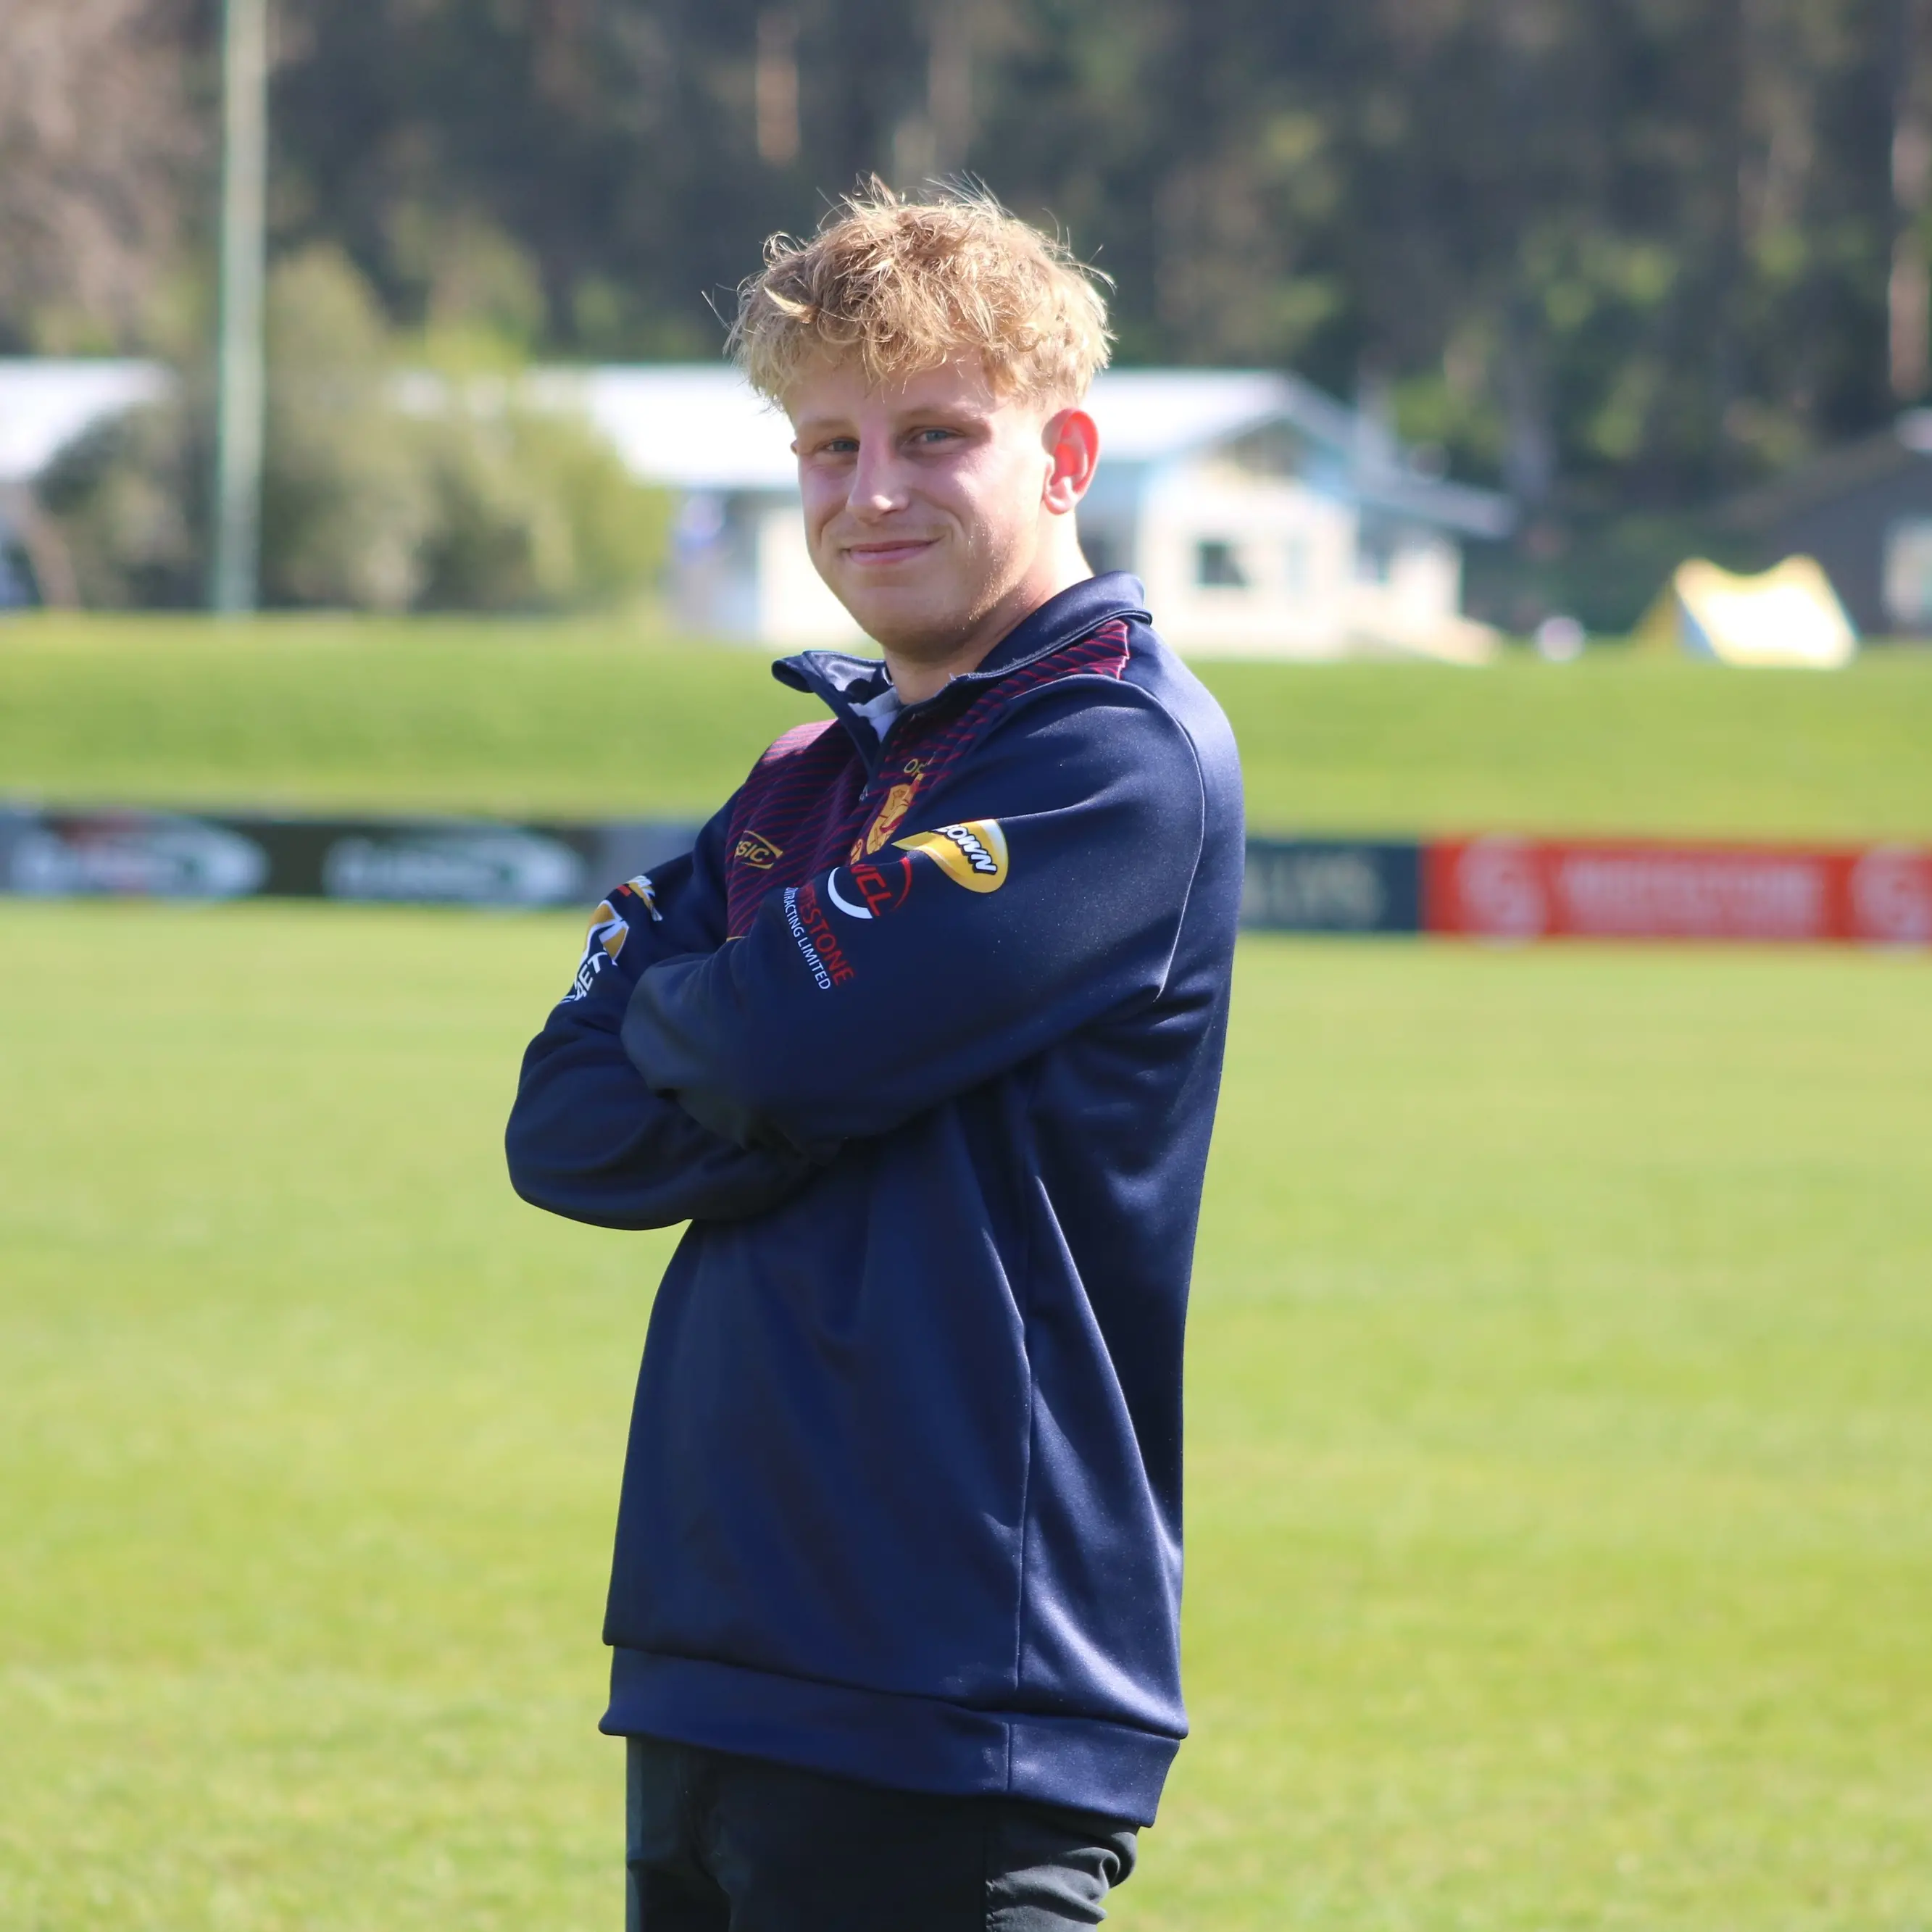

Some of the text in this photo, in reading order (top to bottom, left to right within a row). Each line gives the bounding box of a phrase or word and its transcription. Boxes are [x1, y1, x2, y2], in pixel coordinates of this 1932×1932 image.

[734, 841, 770, 862] SIC
[935, 825, 998, 873] OWN
[797, 937, 831, 991] LIMITED
